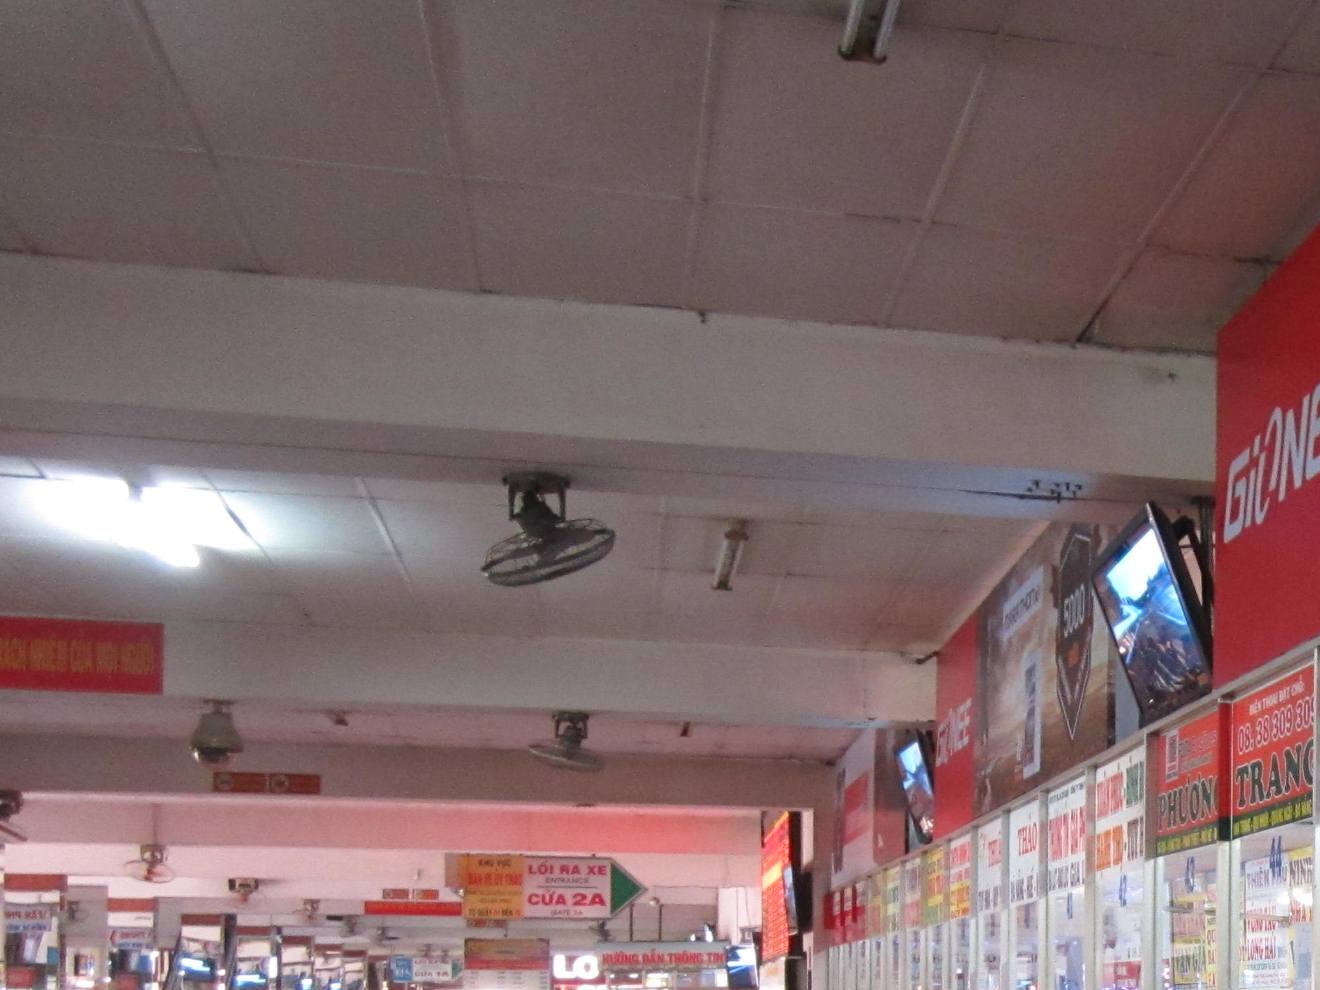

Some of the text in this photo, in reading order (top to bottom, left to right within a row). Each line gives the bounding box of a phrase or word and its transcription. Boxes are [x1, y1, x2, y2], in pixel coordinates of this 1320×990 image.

[1272, 704, 1293, 739] 309
[527, 860, 608, 876] LỐI RA XE
[527, 888, 608, 907] CỬA 2A
